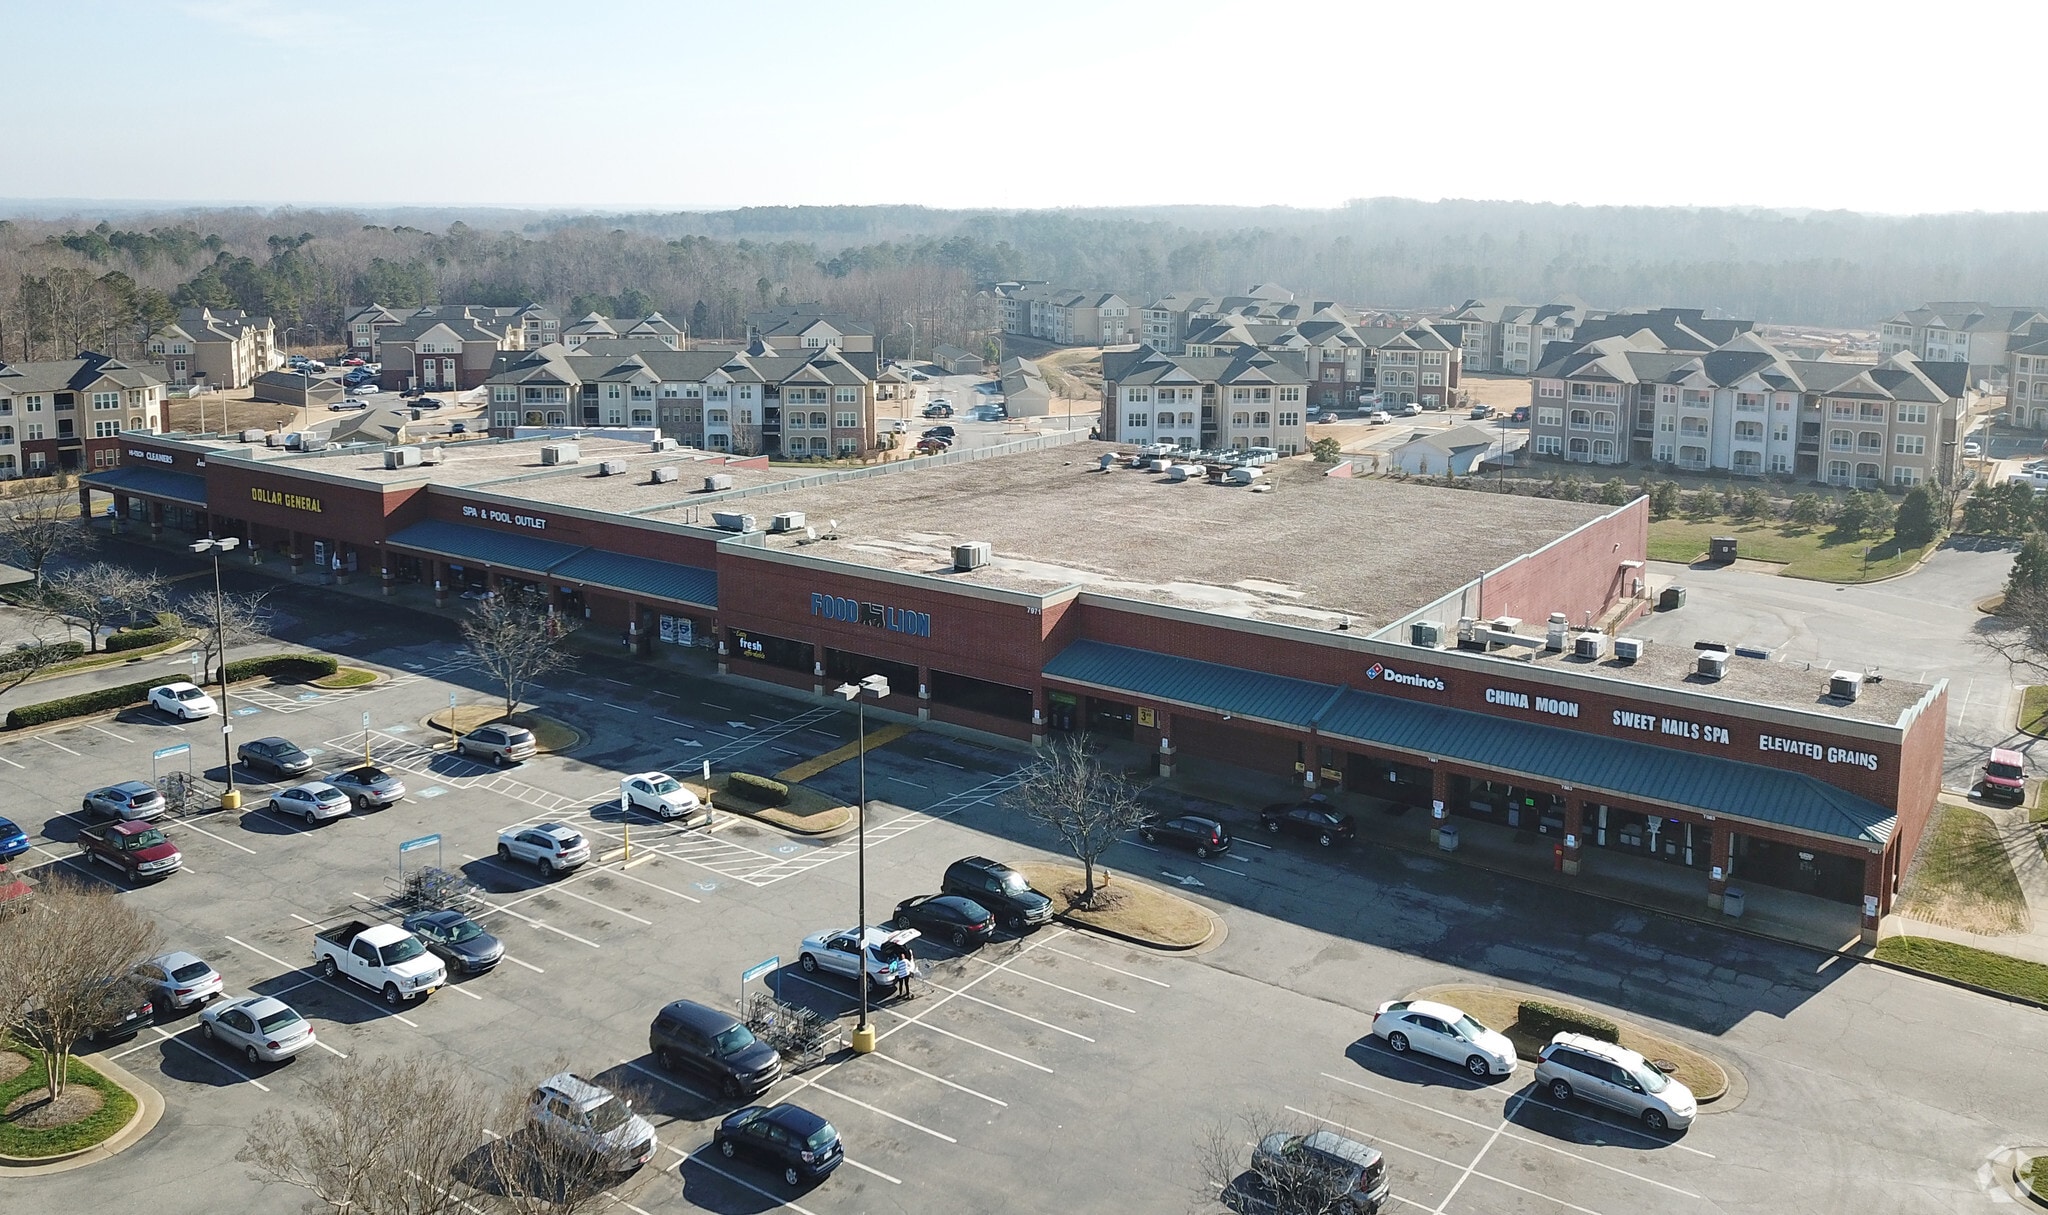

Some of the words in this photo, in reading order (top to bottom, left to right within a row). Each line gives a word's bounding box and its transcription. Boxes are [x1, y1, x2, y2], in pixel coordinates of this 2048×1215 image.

[146, 451, 173, 464] CLEANERS
[252, 487, 283, 506] DOLLAR
[284, 493, 322, 513] GENERAL
[462, 505, 478, 518] SPA
[481, 509, 487, 519] &
[489, 510, 512, 524] POOL
[514, 515, 546, 529] OUTLET
[811, 592, 858, 624] FOOD
[887, 606, 931, 638] LION
[1026, 606, 1041, 616] 7971
[739, 637, 763, 652] fresh
[1383, 668, 1445, 691] Domino's
[1485, 688, 1530, 709] CHINA
[1535, 696, 1579, 718] MOON
[1612, 710, 1656, 731] SWEET
[1661, 718, 1700, 740] NAILS
[1703, 725, 1730, 745] SPA
[1759, 734, 1823, 761] ELEVATED
[1827, 747, 1879, 771] GRAINS
